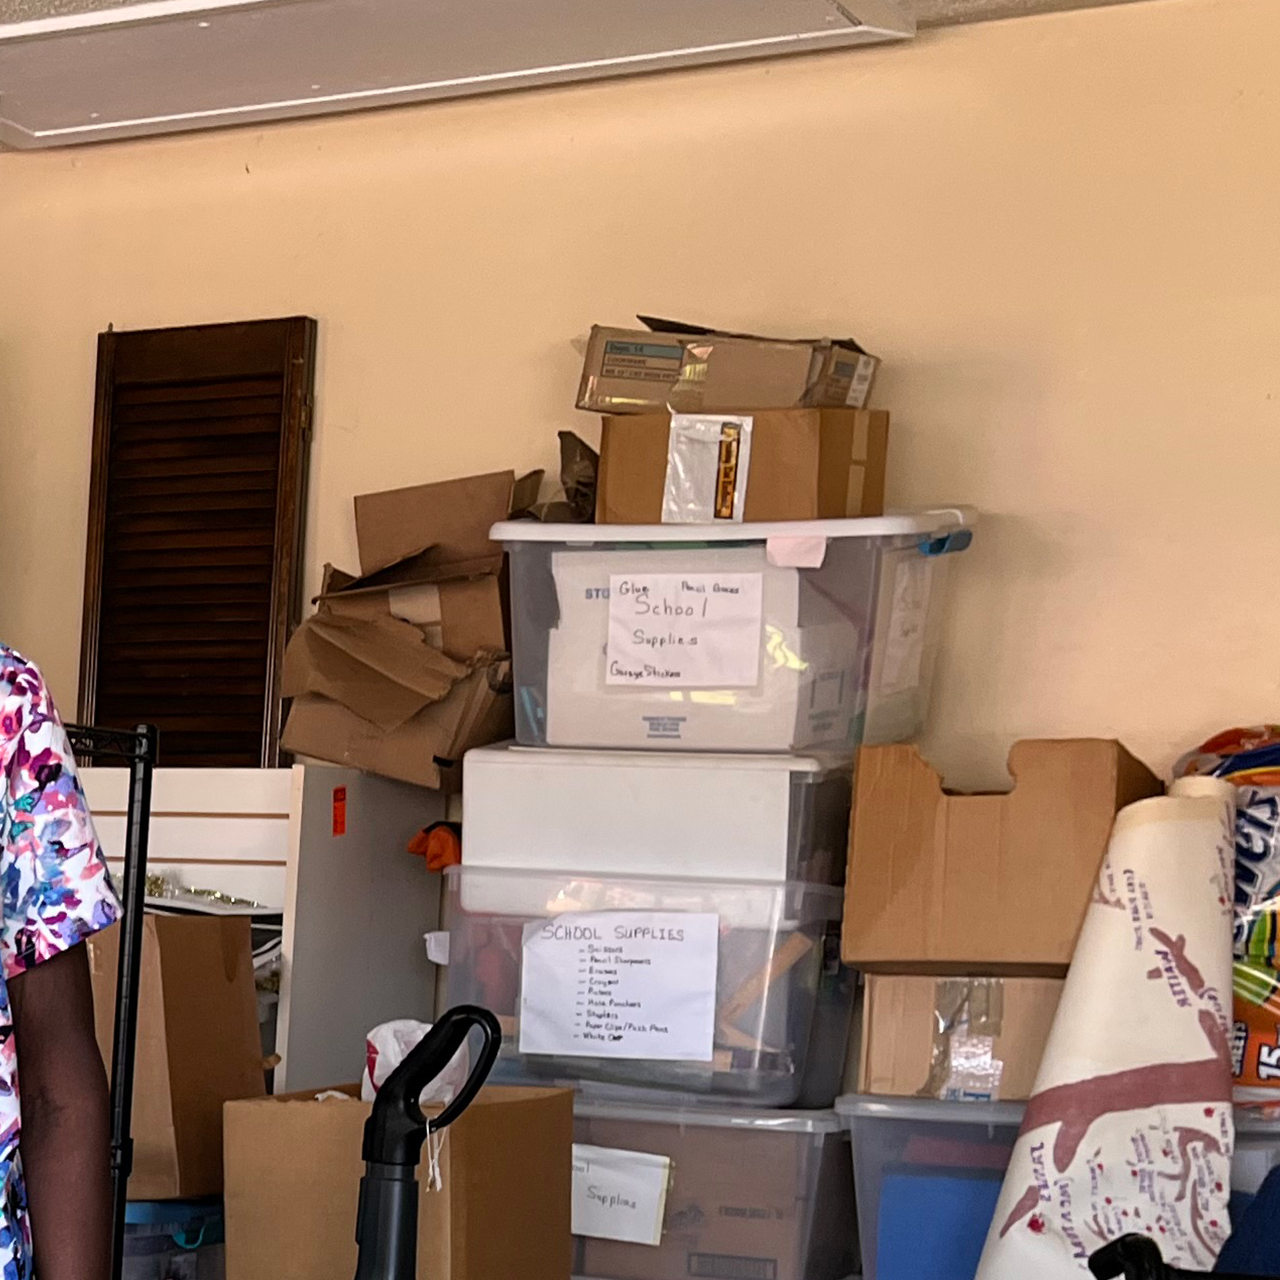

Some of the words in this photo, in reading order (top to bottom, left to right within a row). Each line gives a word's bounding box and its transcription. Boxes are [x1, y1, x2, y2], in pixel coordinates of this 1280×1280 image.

[619, 580, 650, 596] Glue
[635, 593, 708, 618] School
[632, 628, 698, 649] Supplies
[541, 923, 602, 941] SCHOOL
[614, 925, 685, 942] SUPPLIES
[586, 1186, 637, 1210] Supplies
